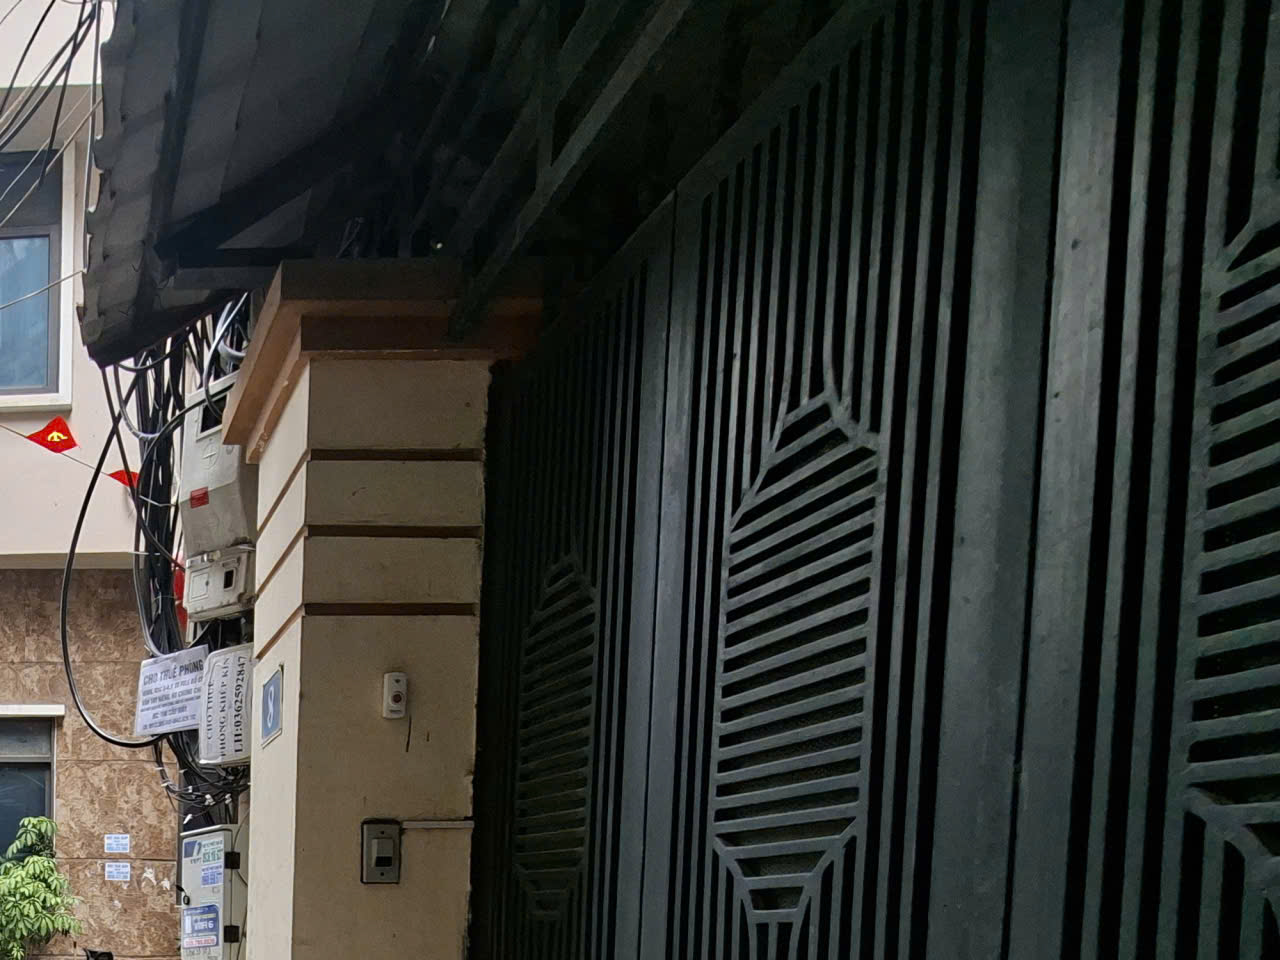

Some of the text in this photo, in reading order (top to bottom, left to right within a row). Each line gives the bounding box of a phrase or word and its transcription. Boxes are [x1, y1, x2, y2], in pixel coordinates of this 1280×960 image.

[143, 658, 203, 686] CHO THUÊ PHÒNG
[221, 657, 230, 677] KÍN
[206, 680, 214, 711] THUÊ
[219, 681, 227, 713] KHÉP
[233, 656, 246, 753] LH:0362592847
[266, 684, 274, 729] 8
